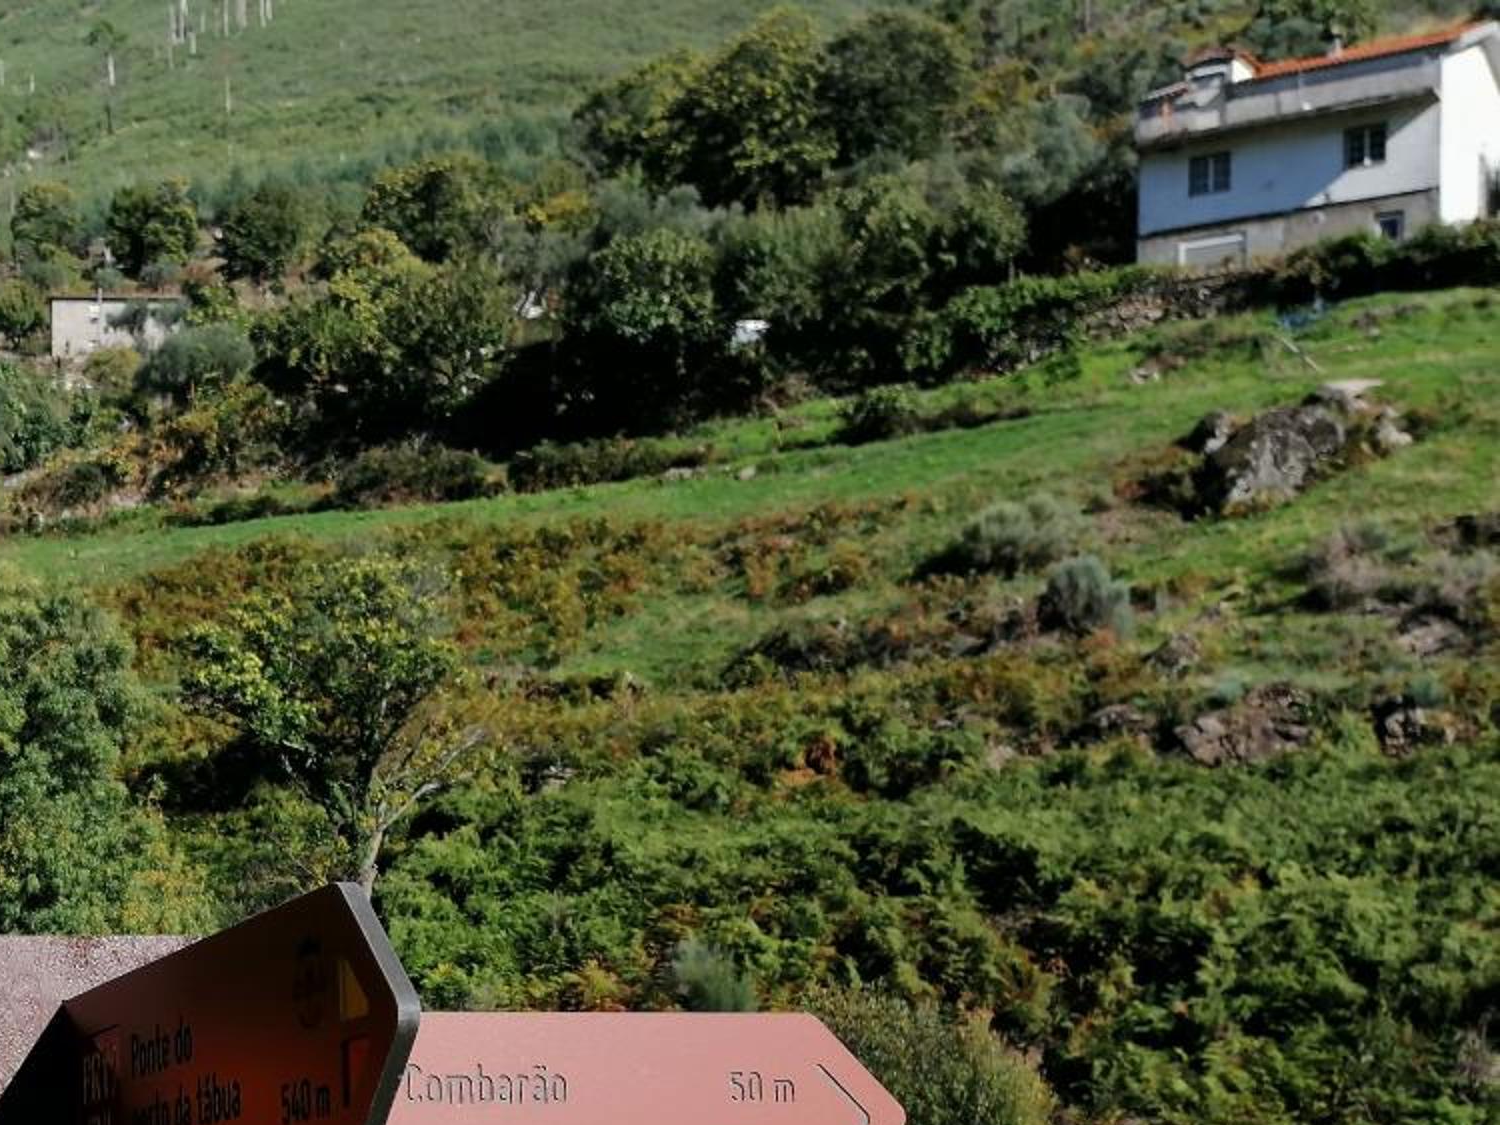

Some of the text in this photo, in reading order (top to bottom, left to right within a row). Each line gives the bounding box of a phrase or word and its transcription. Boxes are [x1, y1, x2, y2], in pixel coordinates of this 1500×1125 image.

[131, 1015, 193, 1080] Ponte do
[196, 1071, 242, 1125] tábua
[281, 1078, 331, 1125] 540 m
[405, 1063, 568, 1105] Combarão
[729, 1071, 796, 1103] 50 m
